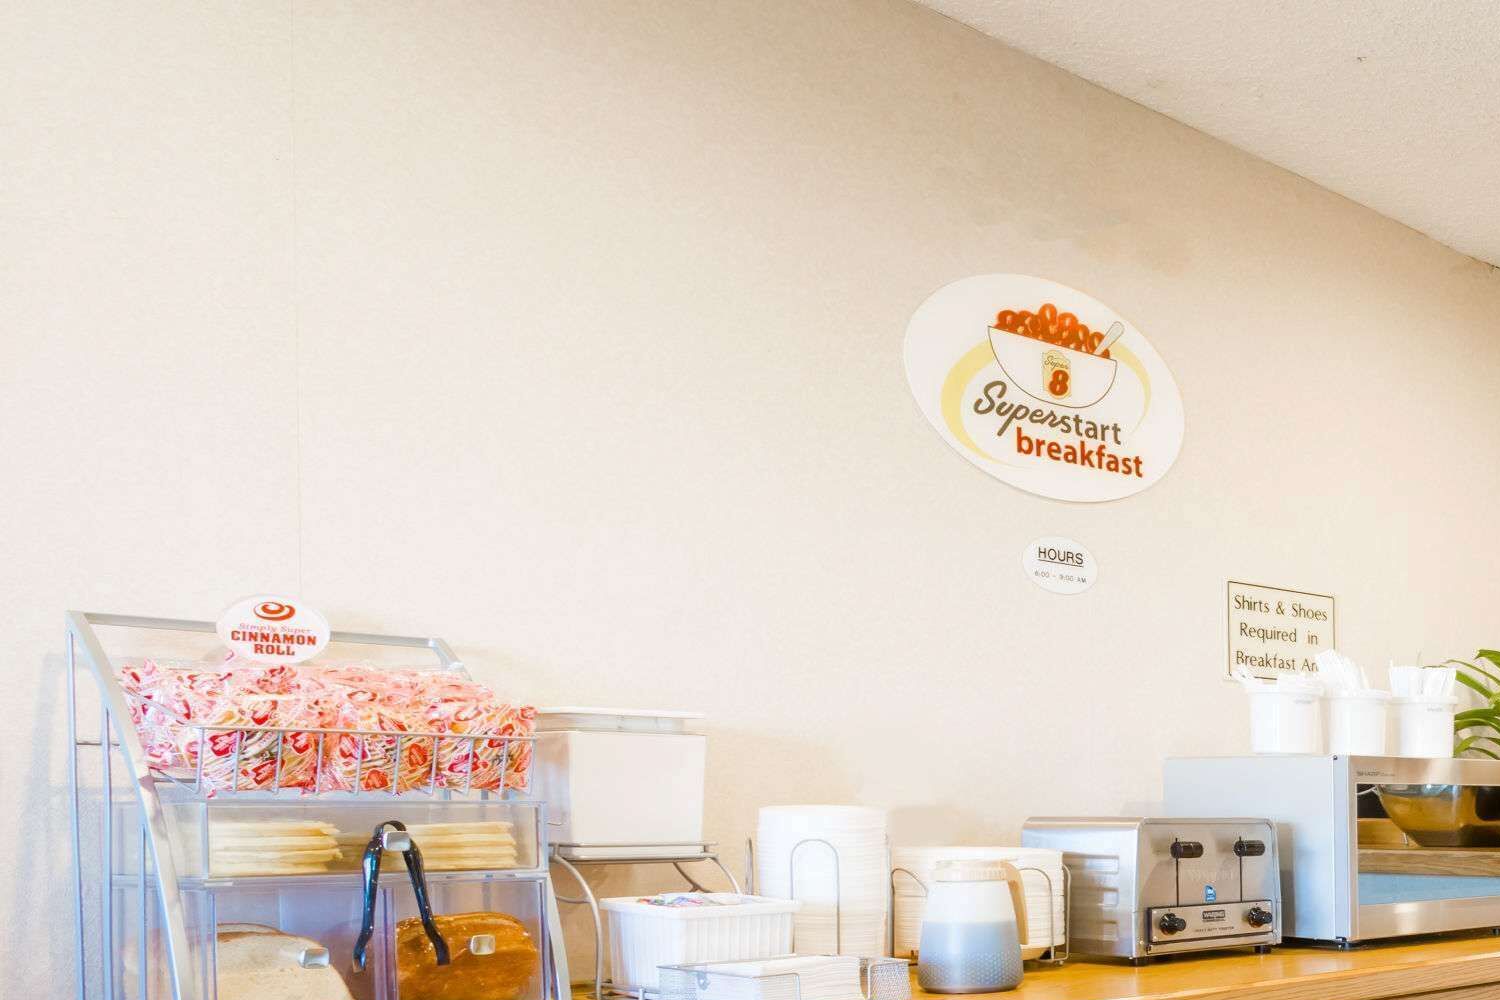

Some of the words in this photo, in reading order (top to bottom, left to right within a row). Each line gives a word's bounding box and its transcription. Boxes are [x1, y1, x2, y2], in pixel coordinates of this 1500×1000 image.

[1049, 370, 1070, 396] 8
[973, 380, 1121, 445] Superstart
[1016, 426, 1143, 478] breakfast
[1038, 547, 1084, 565] HOURS
[1234, 594, 1270, 614] Shirts
[1275, 601, 1285, 615] &
[1291, 603, 1328, 621] Shoes
[230, 630, 317, 646] CINNAMON
[1240, 622, 1297, 643] Required
[1307, 630, 1318, 645] in
[253, 643, 296, 656] ROLL
[1236, 650, 1296, 671] Breakfast
